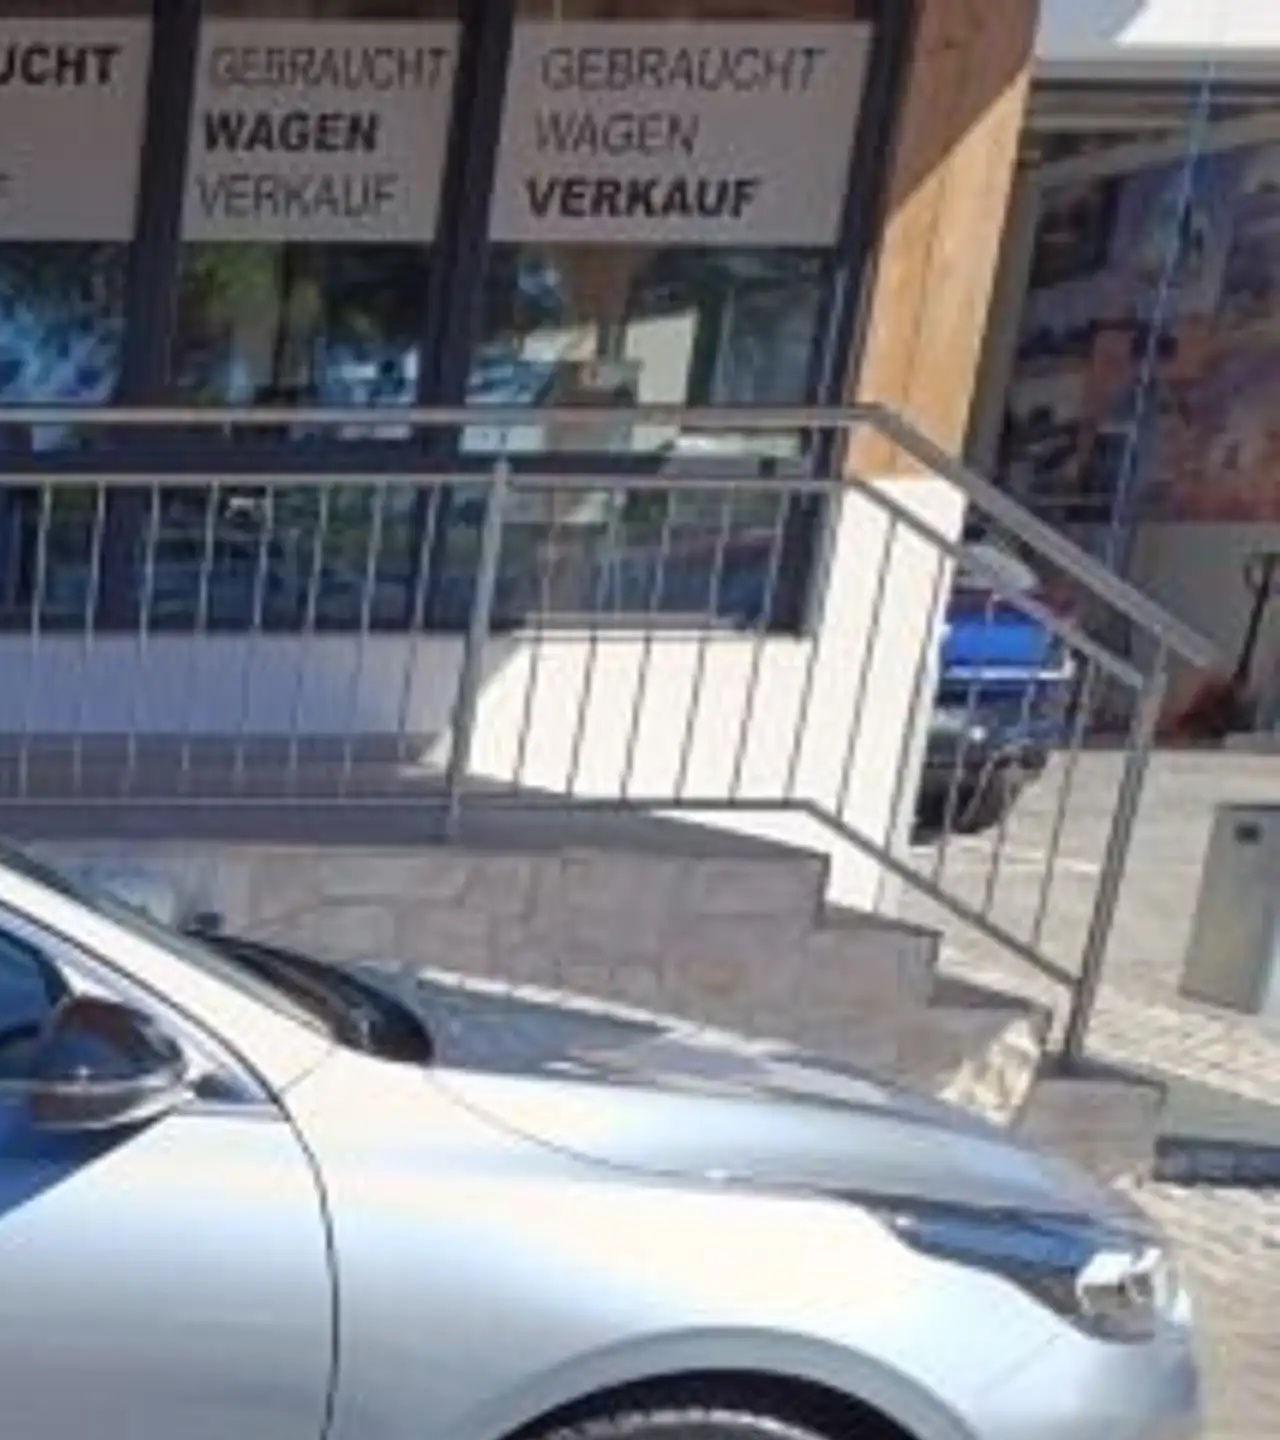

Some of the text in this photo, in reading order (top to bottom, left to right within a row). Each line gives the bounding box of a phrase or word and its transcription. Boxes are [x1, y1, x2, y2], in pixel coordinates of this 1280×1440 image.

[211, 46, 449, 90] GEBRAUCHT
[541, 47, 826, 91] GEBRAUCHT
[204, 109, 380, 153] WAGEN
[535, 111, 699, 156] WAGEN
[195, 172, 399, 217] VERKAUF
[526, 176, 760, 218] VERKAUF
